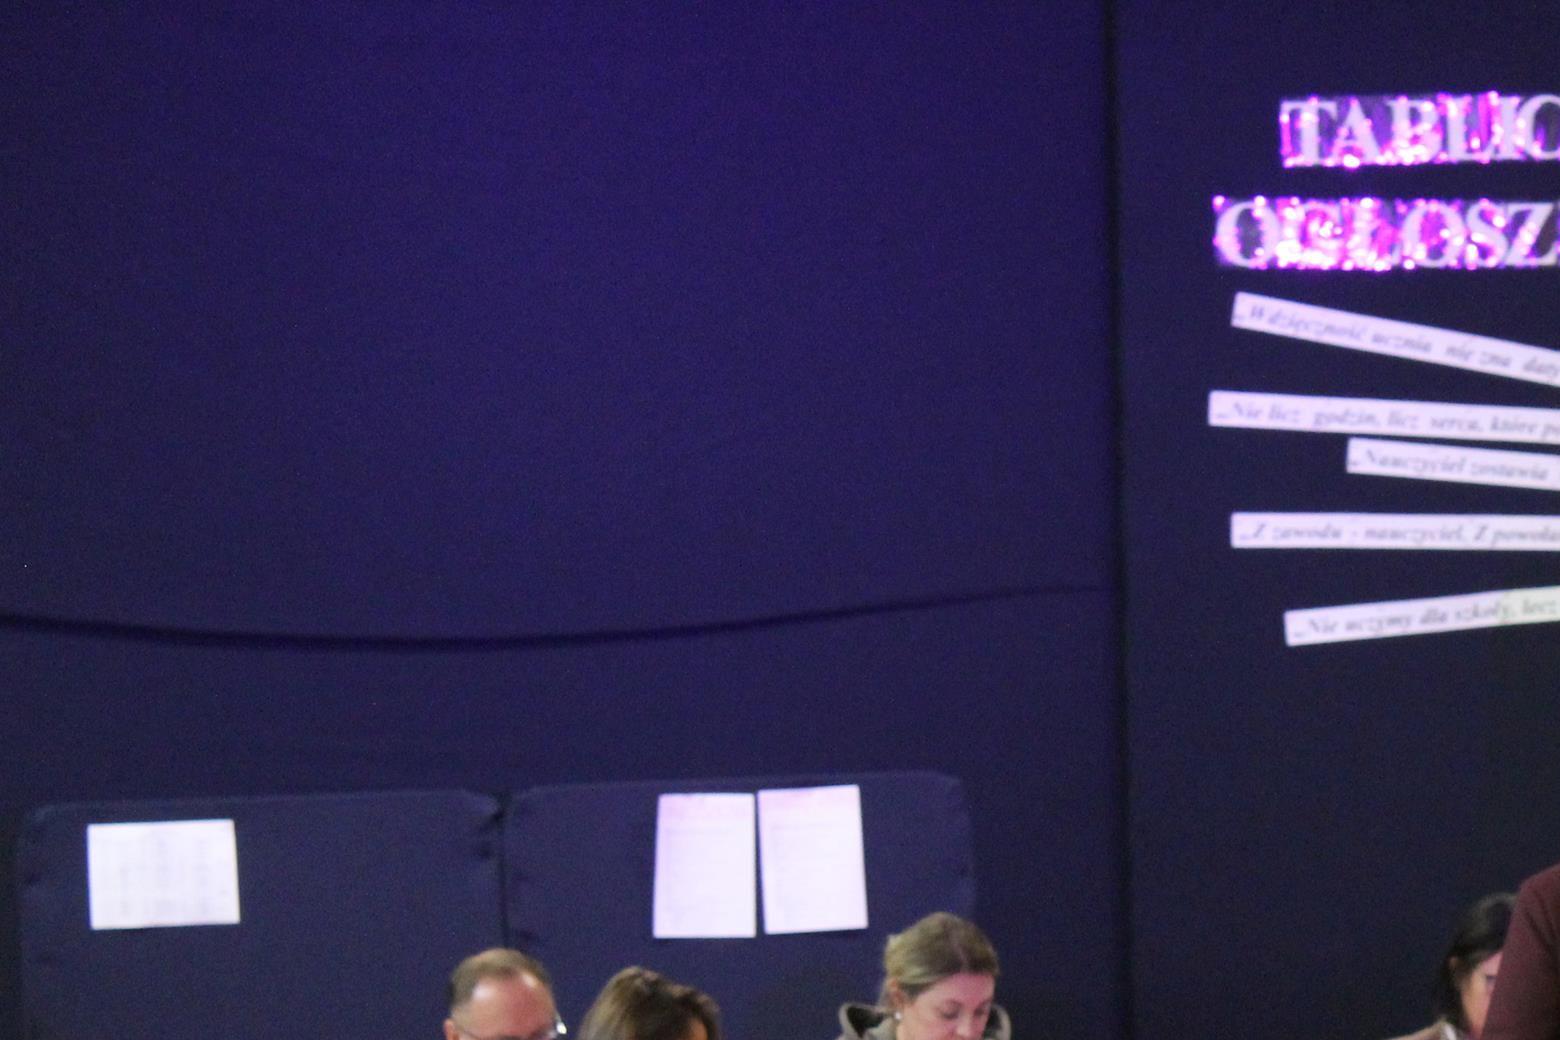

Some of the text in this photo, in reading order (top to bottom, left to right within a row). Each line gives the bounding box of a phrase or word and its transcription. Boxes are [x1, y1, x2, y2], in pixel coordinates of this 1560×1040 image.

[1445, 342, 1472, 361] nie
[1479, 350, 1512, 368] zna
[1522, 355, 1560, 379] daty
[1268, 404, 1301, 422] licz
[1386, 410, 1419, 429] licz
[1489, 415, 1537, 434] które
[1471, 462, 1549, 481] zostawia
[1273, 522, 1342, 540] zawodu
[1346, 614, 1411, 636] uczymy
[1420, 607, 1448, 624] dla
[1522, 598, 1556, 614] lecz
